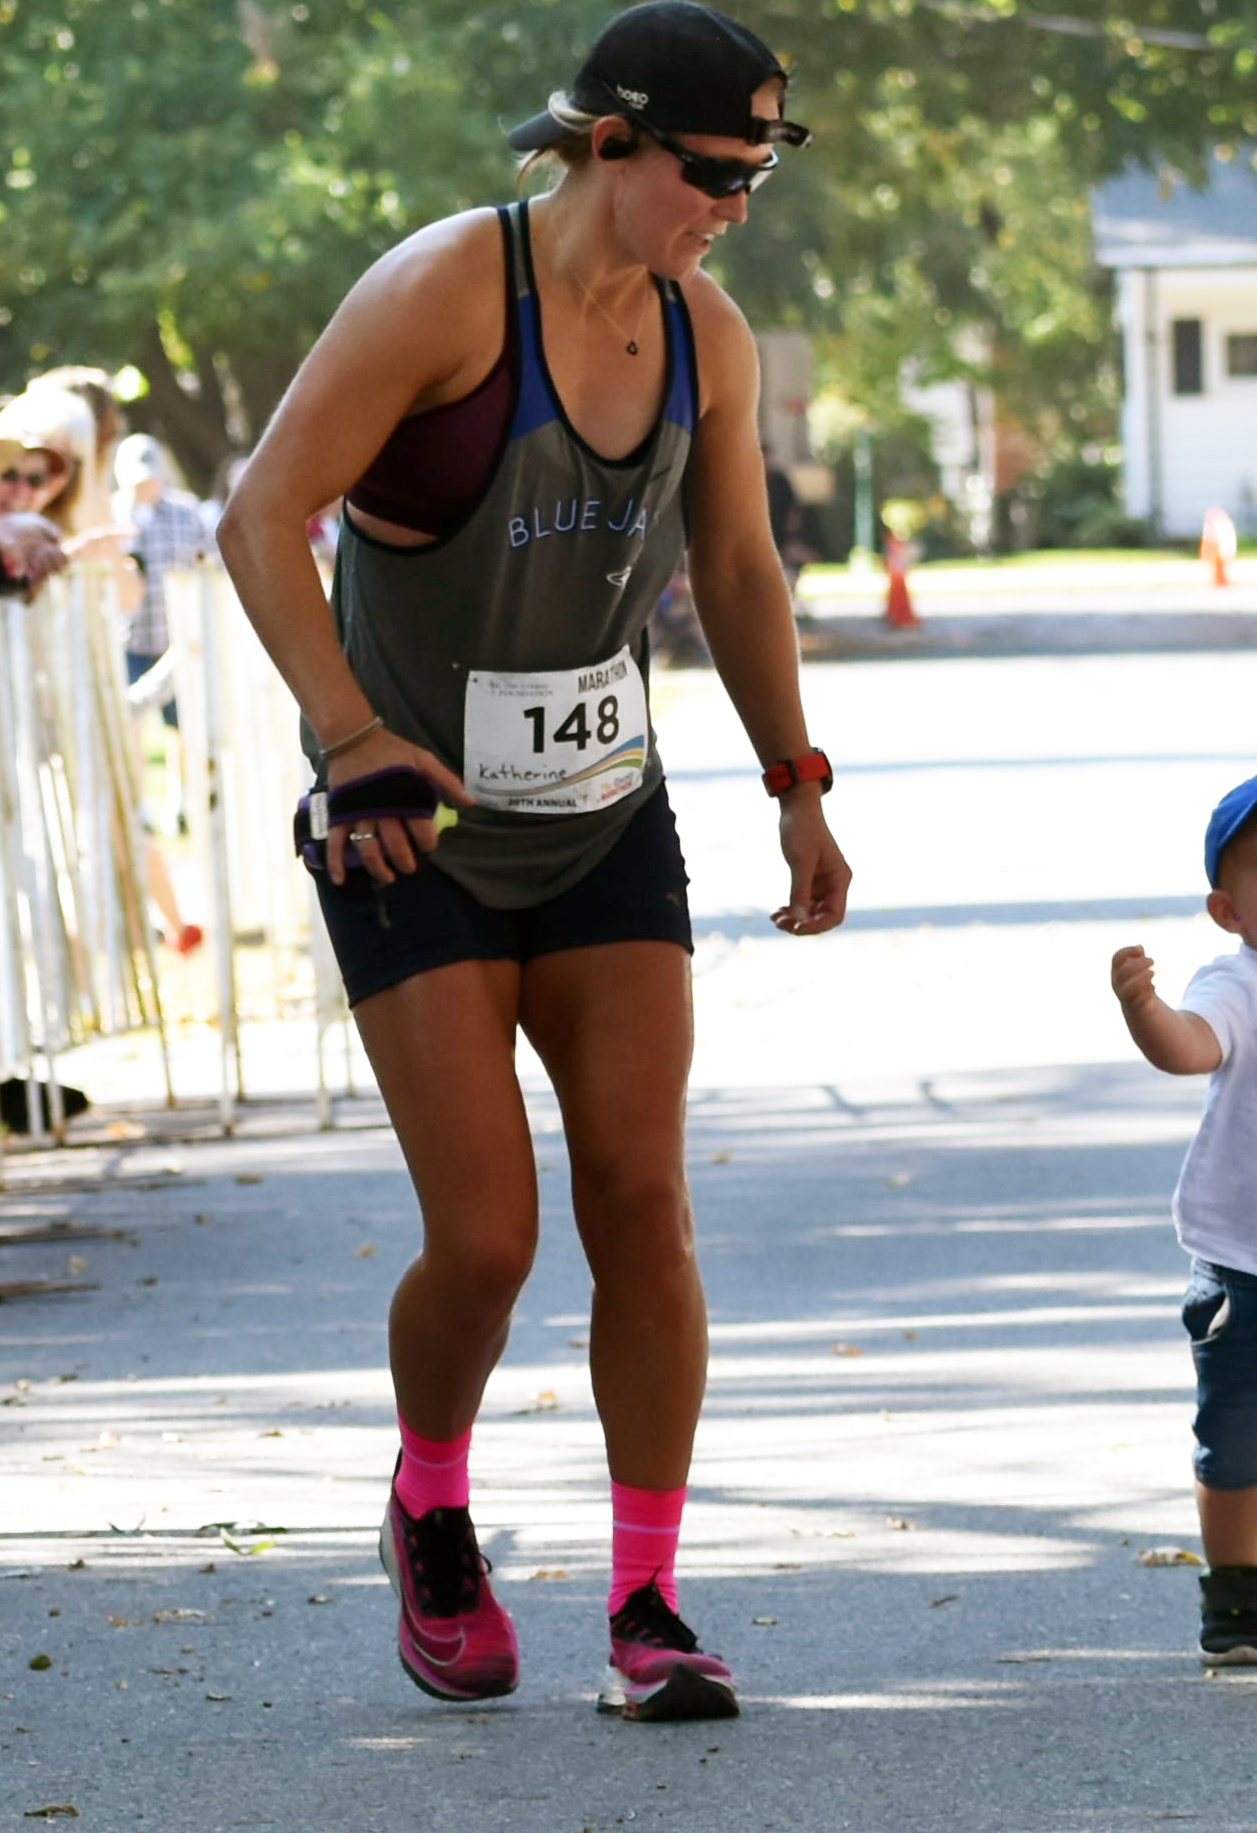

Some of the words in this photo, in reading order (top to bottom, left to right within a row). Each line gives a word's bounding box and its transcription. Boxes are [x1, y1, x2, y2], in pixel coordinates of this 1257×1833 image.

[508, 500, 601, 547] BLUE
[608, 499, 660, 541] JA
[523, 695, 620, 754] 148
[536, 798, 577, 808] ANNUAL
